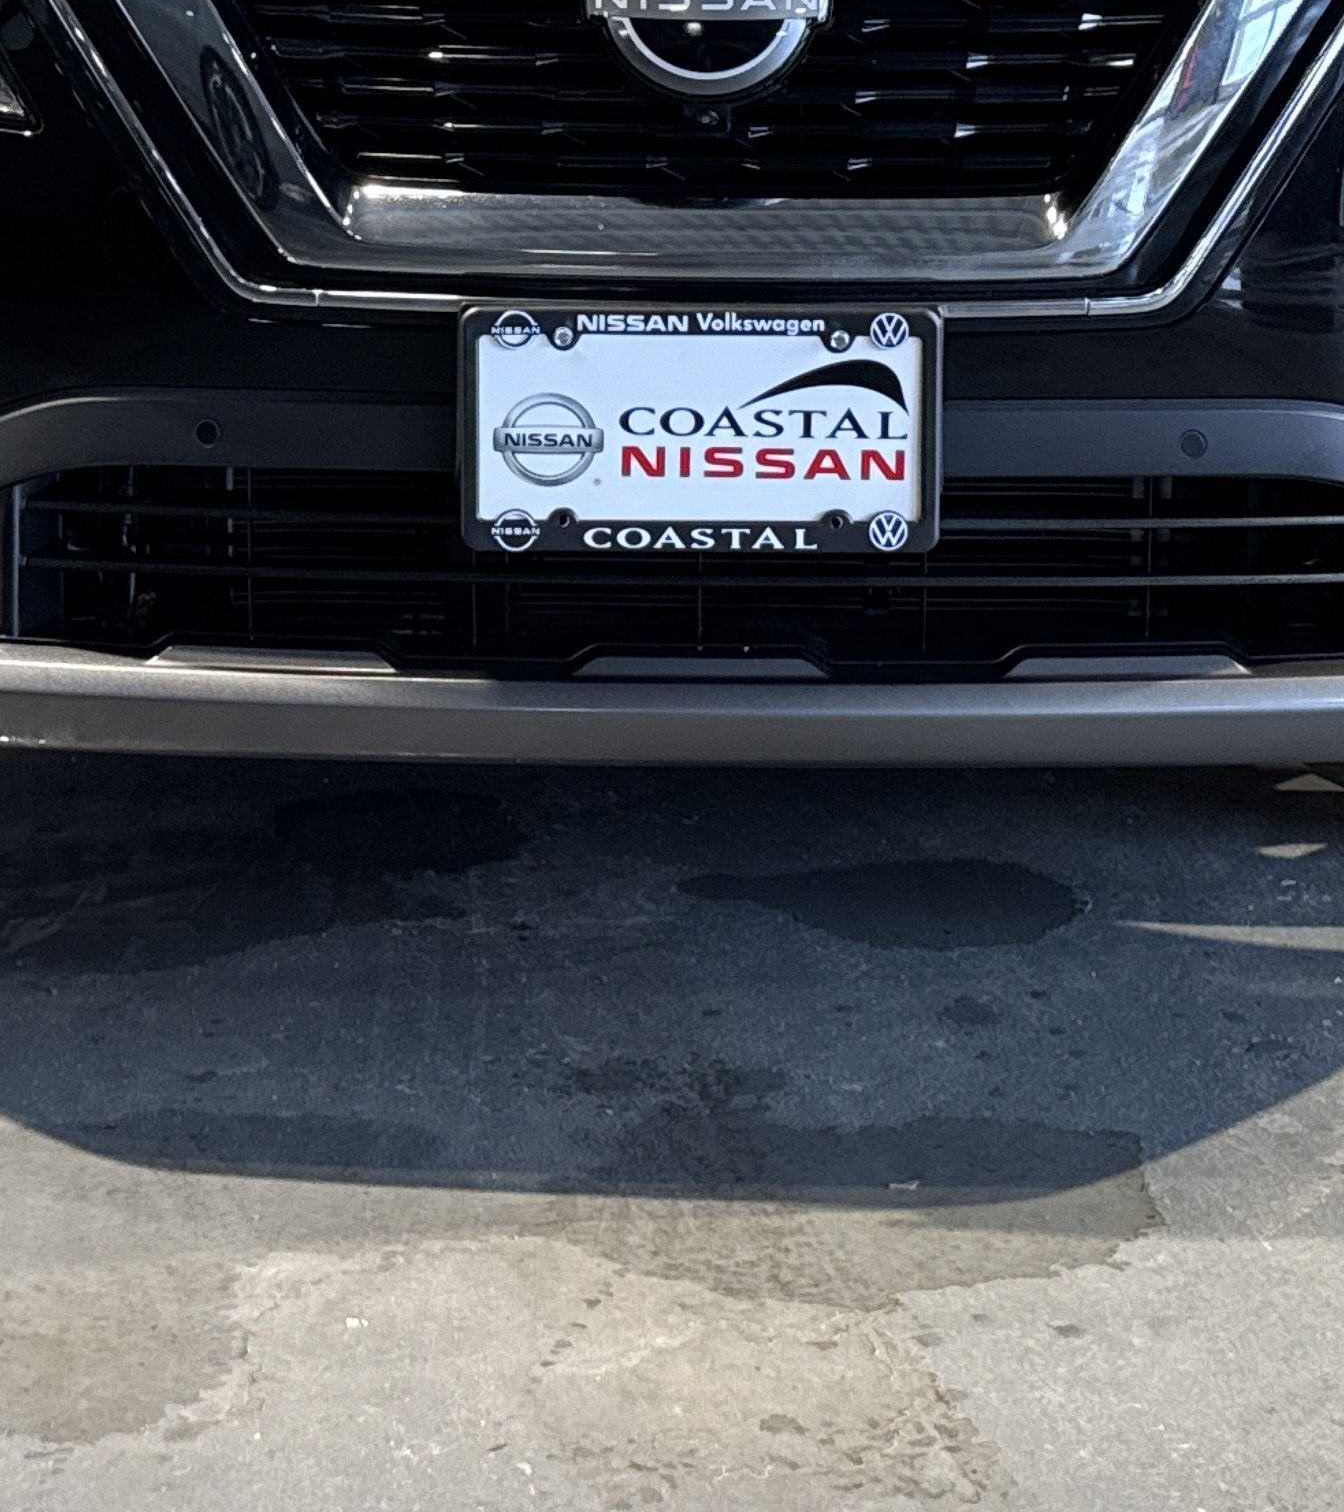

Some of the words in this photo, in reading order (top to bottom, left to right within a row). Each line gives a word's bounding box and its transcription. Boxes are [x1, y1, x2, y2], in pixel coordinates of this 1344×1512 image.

[491, 326, 540, 334] NISSAN
[577, 314, 689, 333] NISSAN
[696, 312, 825, 336] Volkswagen
[619, 406, 908, 440] COASTAL
[504, 433, 593, 448] NISSAN
[620, 446, 906, 481] NISSAN
[583, 527, 818, 550] COASTAL
